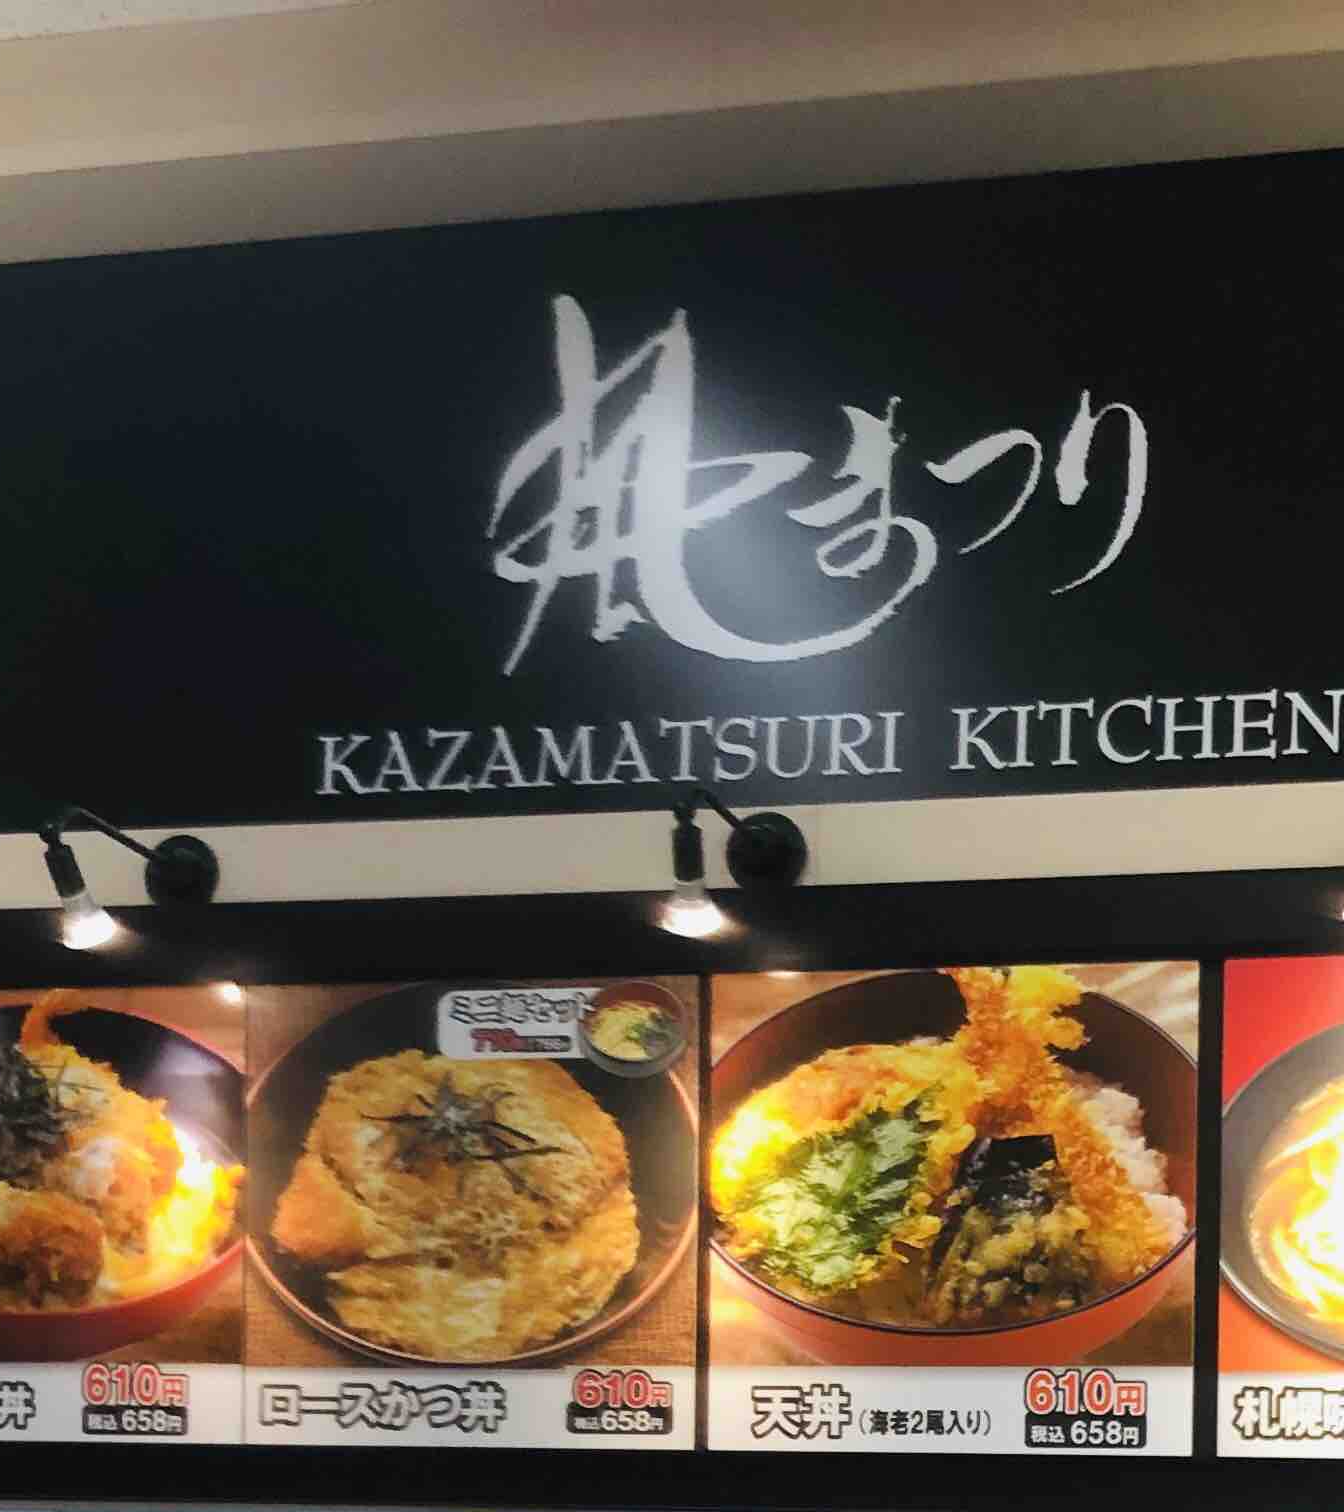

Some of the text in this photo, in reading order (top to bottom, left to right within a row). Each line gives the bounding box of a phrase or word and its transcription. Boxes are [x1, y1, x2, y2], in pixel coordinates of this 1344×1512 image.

[316, 709, 905, 796] KAZAMATSURI
[83, 1363, 188, 1405] 610円
[258, 1380, 508, 1434] ロースかつ丼
[572, 1370, 674, 1409] 610円
[1025, 1369, 1147, 1416] 610円
[751, 1383, 853, 1440] 天丼
